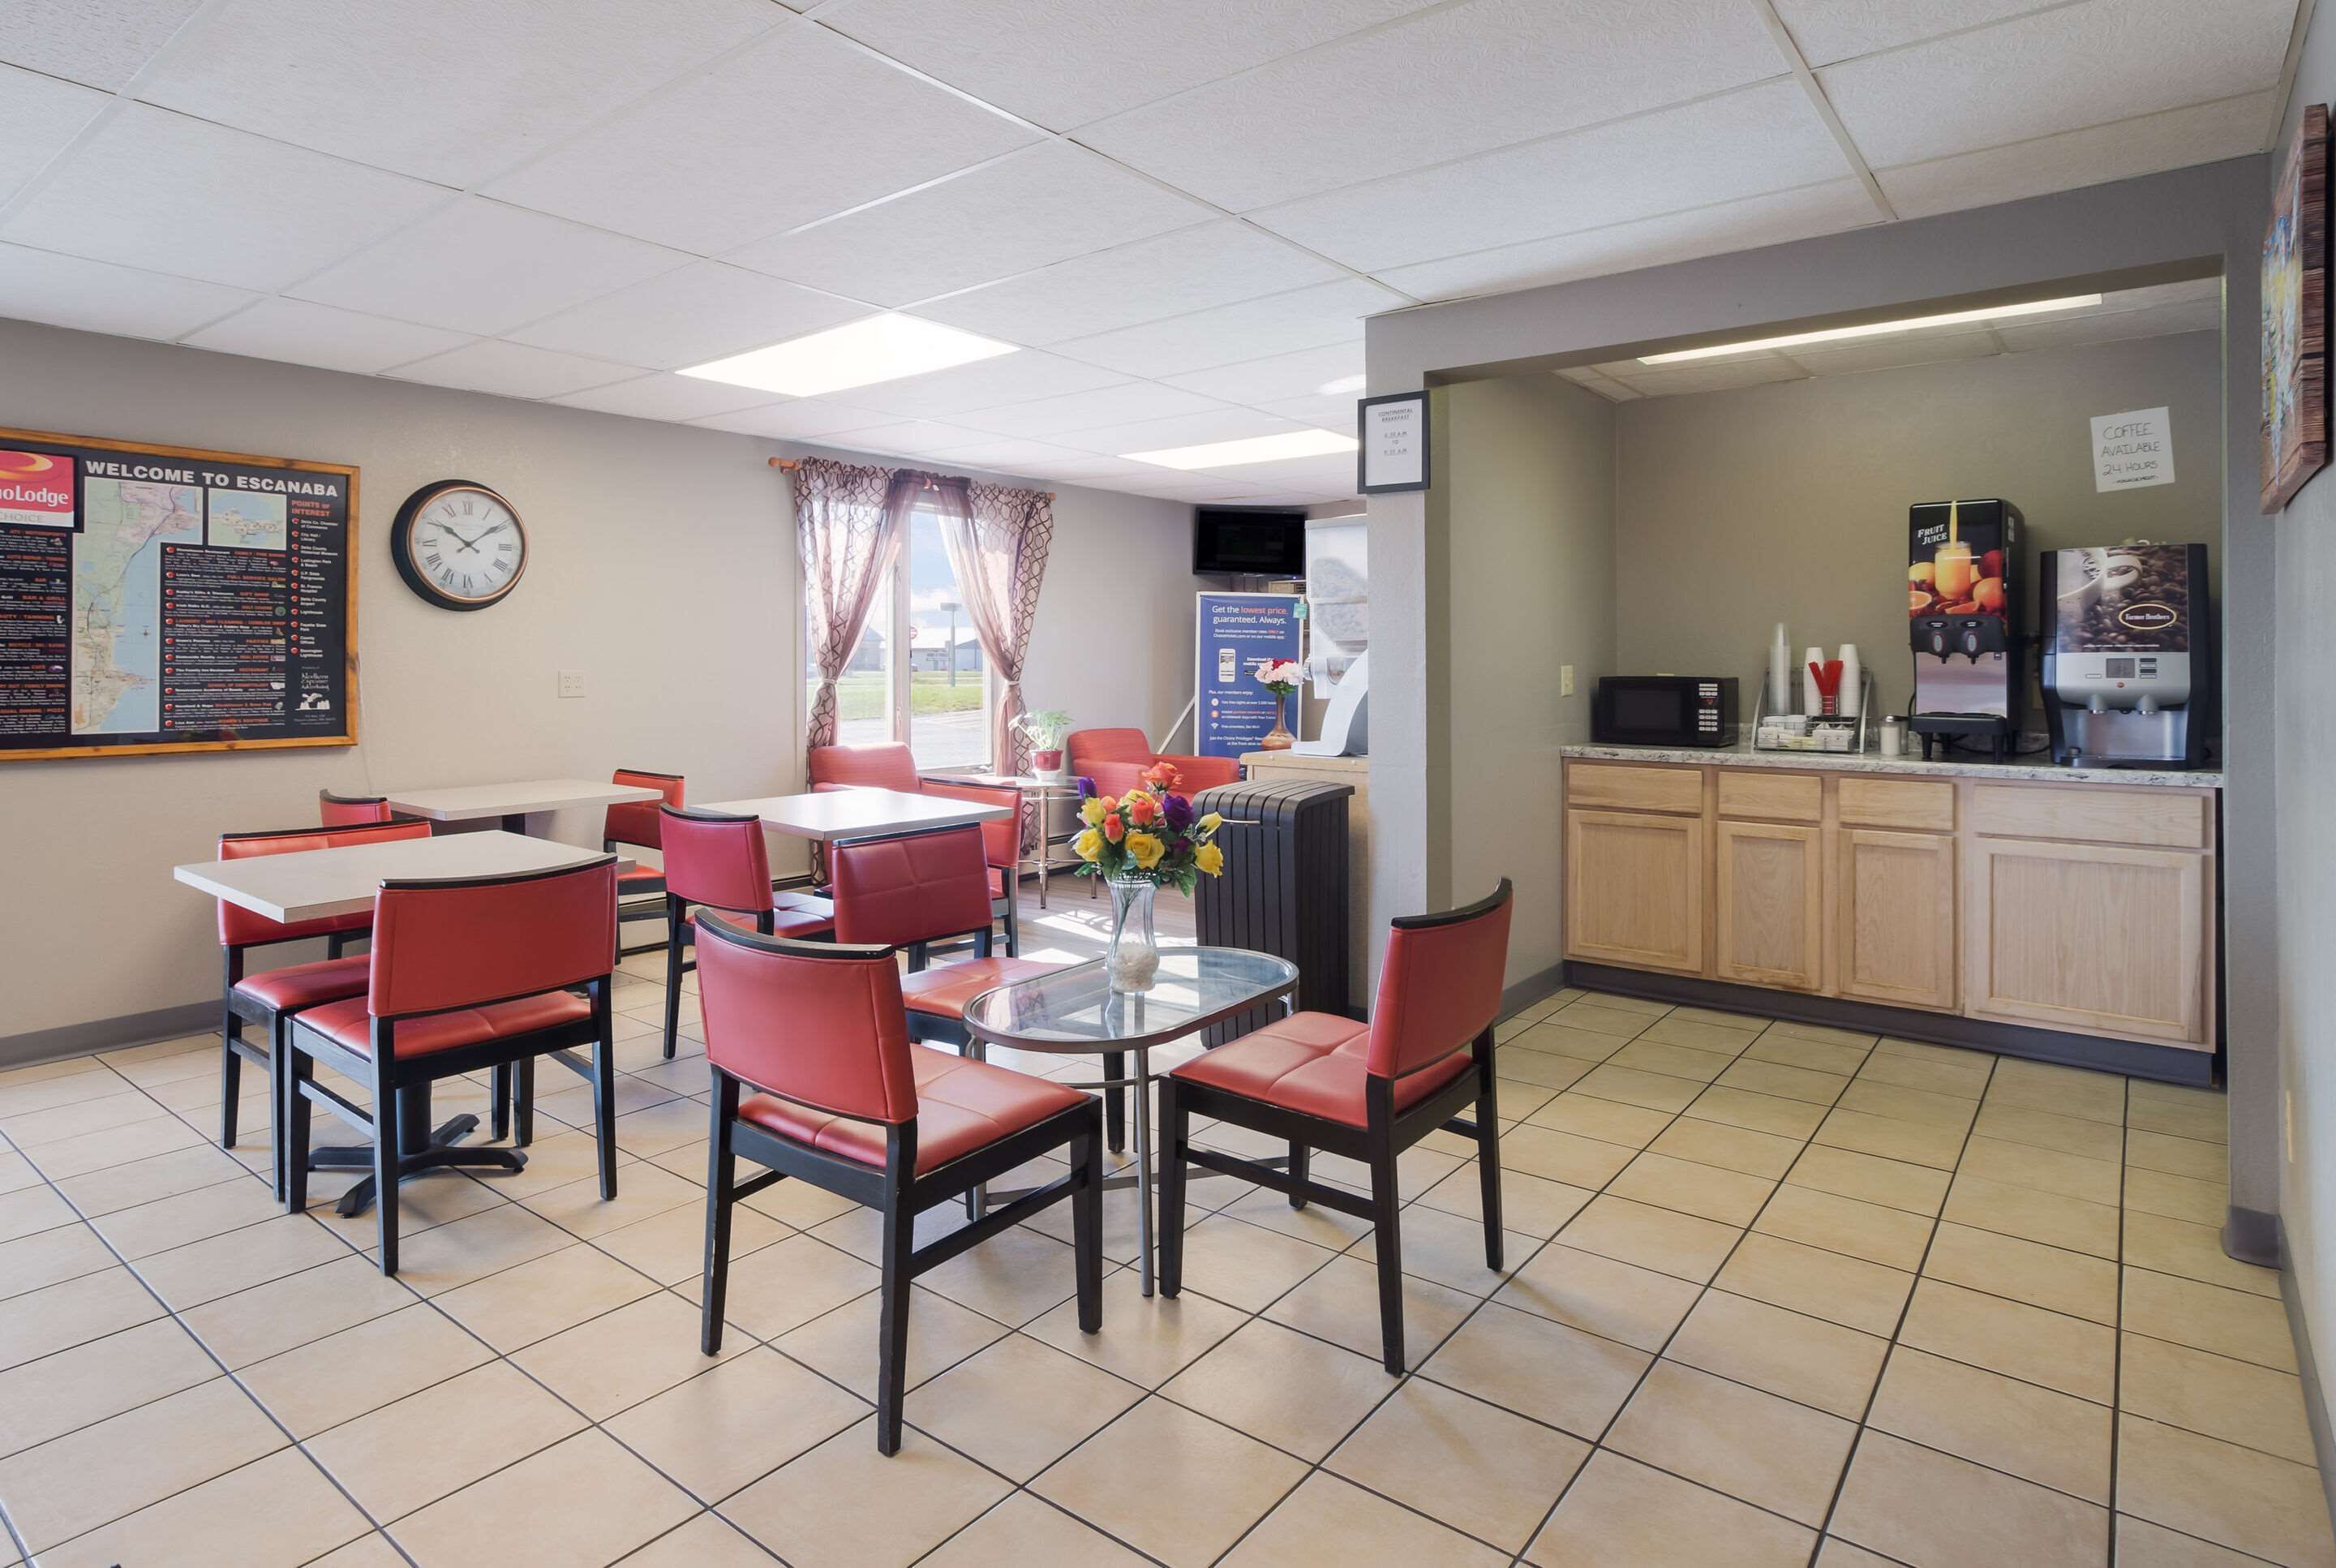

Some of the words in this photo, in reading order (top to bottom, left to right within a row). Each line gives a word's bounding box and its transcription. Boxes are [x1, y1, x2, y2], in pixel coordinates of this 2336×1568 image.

[2103, 423, 2155, 440] COFFEE
[2101, 440, 2162, 458] AVAILABLE
[2102, 463, 2122, 476] 24
[2125, 460, 2158, 472] HOURS
[85, 460, 195, 483] WELCOME
[202, 472, 230, 487] TO
[236, 475, 338, 497] ESCANABA
[292, 507, 331, 517] INTEREST
[1917, 524, 1945, 538] FRUIT
[1922, 532, 1947, 544] JUICE
[1212, 605, 1226, 613] Get
[1241, 606, 1266, 614] lowest
[1213, 616, 1258, 625] guaranteed.
[1259, 616, 1286, 625] Always.
